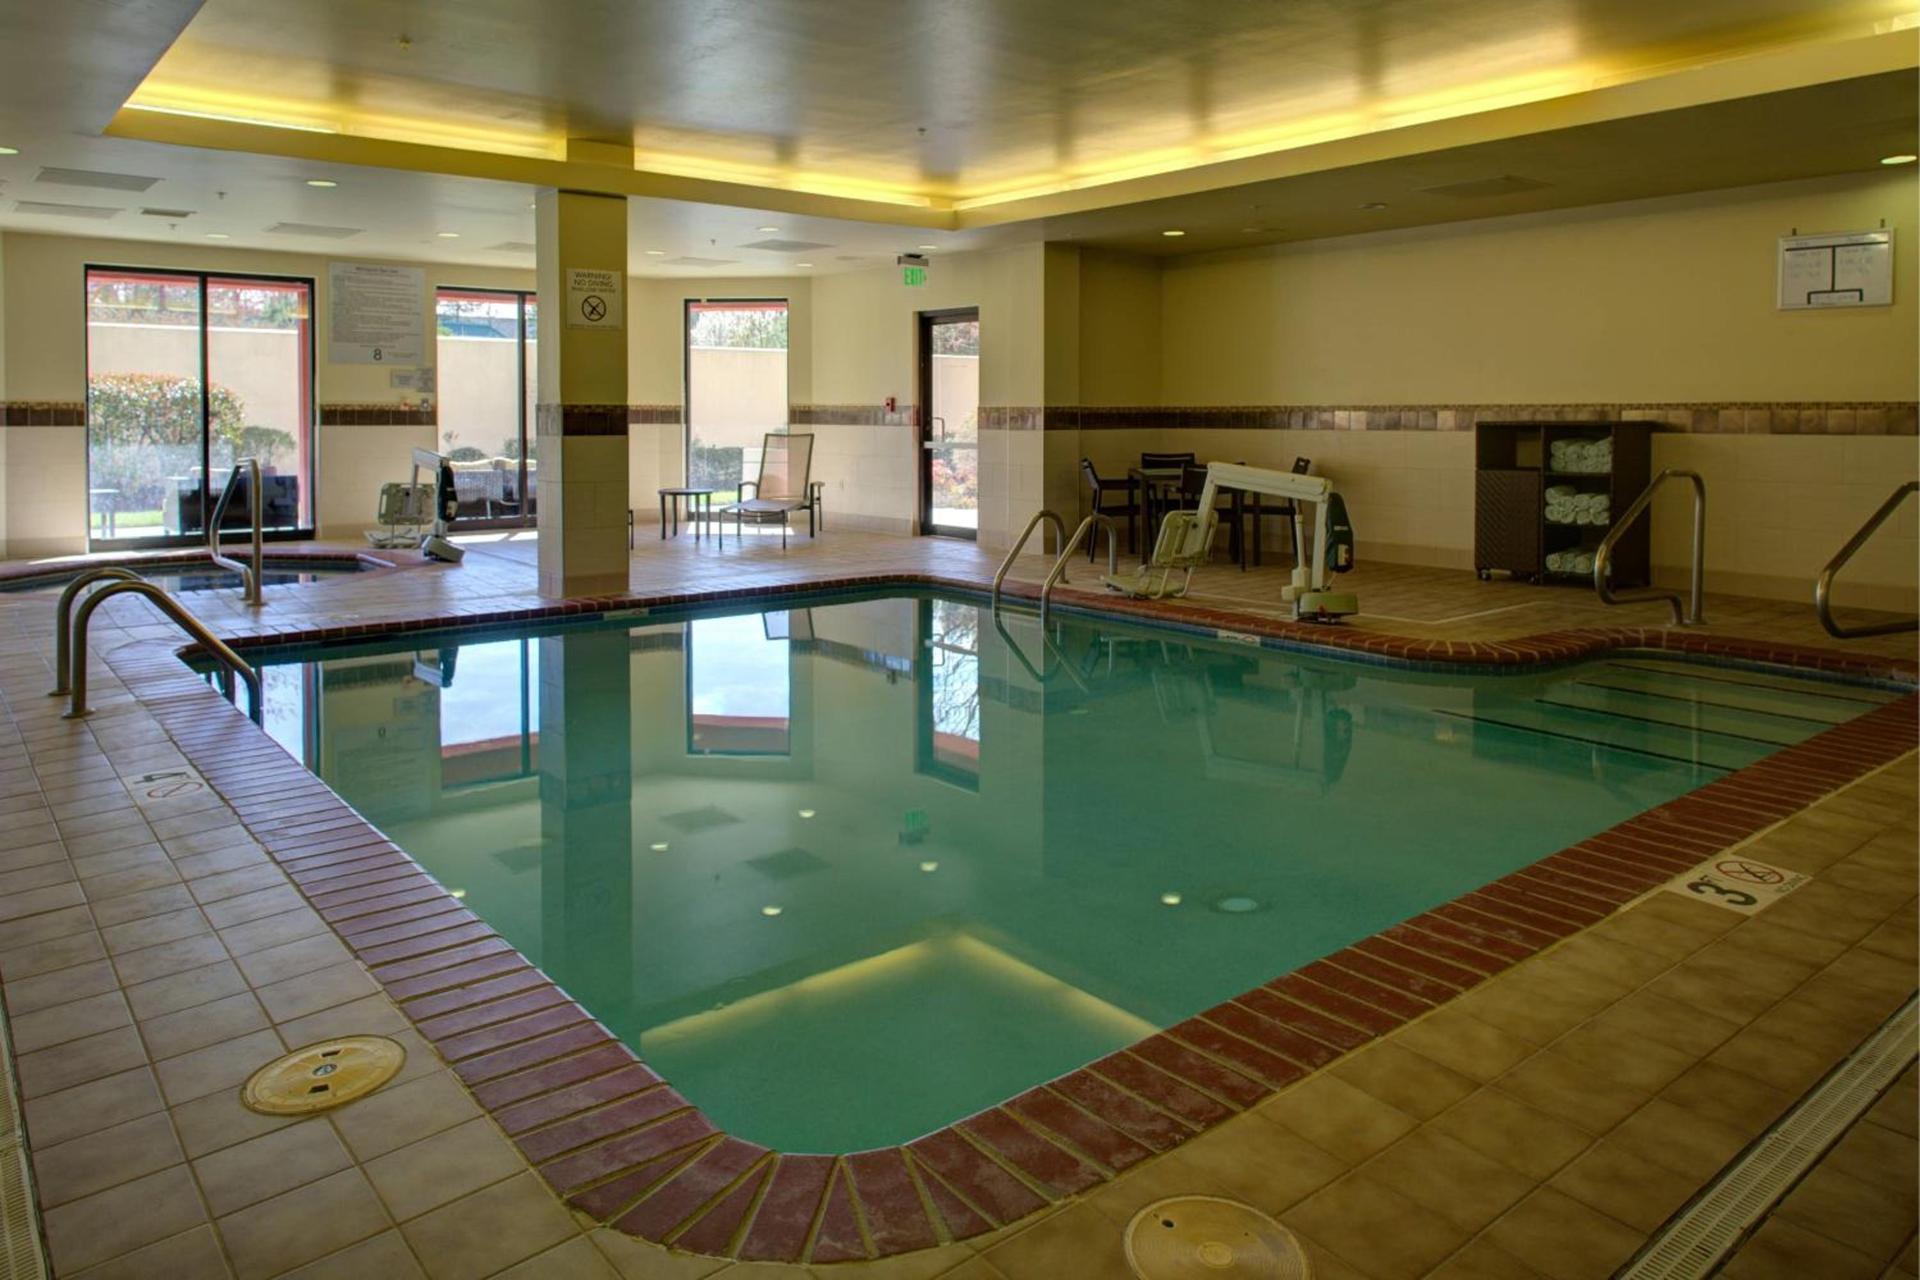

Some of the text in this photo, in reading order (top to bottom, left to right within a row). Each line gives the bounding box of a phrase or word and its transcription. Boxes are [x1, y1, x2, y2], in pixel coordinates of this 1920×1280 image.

[904, 267, 923, 285] EXIT
[373, 348, 382, 361] 8
[1687, 881, 1757, 906] 3
